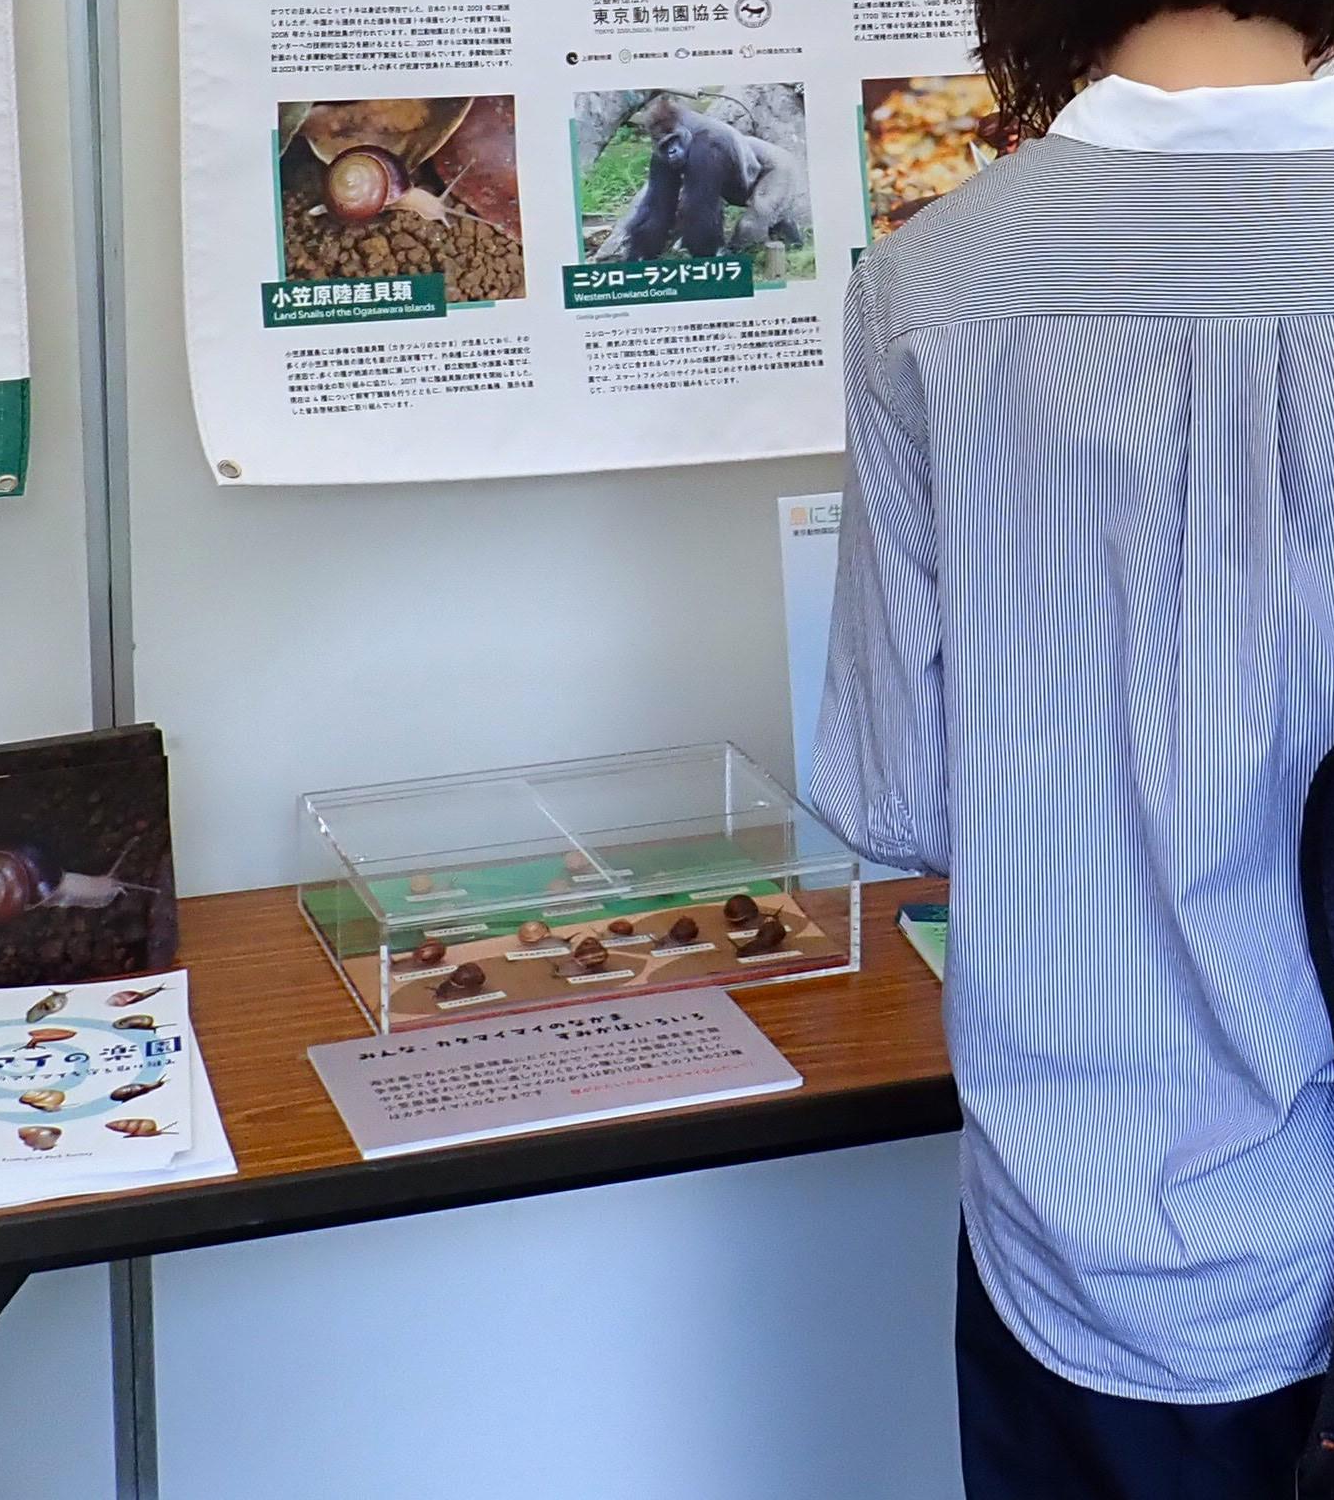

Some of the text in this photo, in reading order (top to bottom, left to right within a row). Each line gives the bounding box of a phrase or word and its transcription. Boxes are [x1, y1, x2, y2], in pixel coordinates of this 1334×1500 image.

[592, 3, 730, 26] 東京動物園協会
[572, 261, 743, 290] ニシローランドゴリラ
[271, 280, 413, 309] 小笠原陸産貝類
[573, 290, 612, 302] Western
[612, 288, 649, 301] Lowland
[273, 302, 436, 321] Land Snails of the Ogasawara Islands
